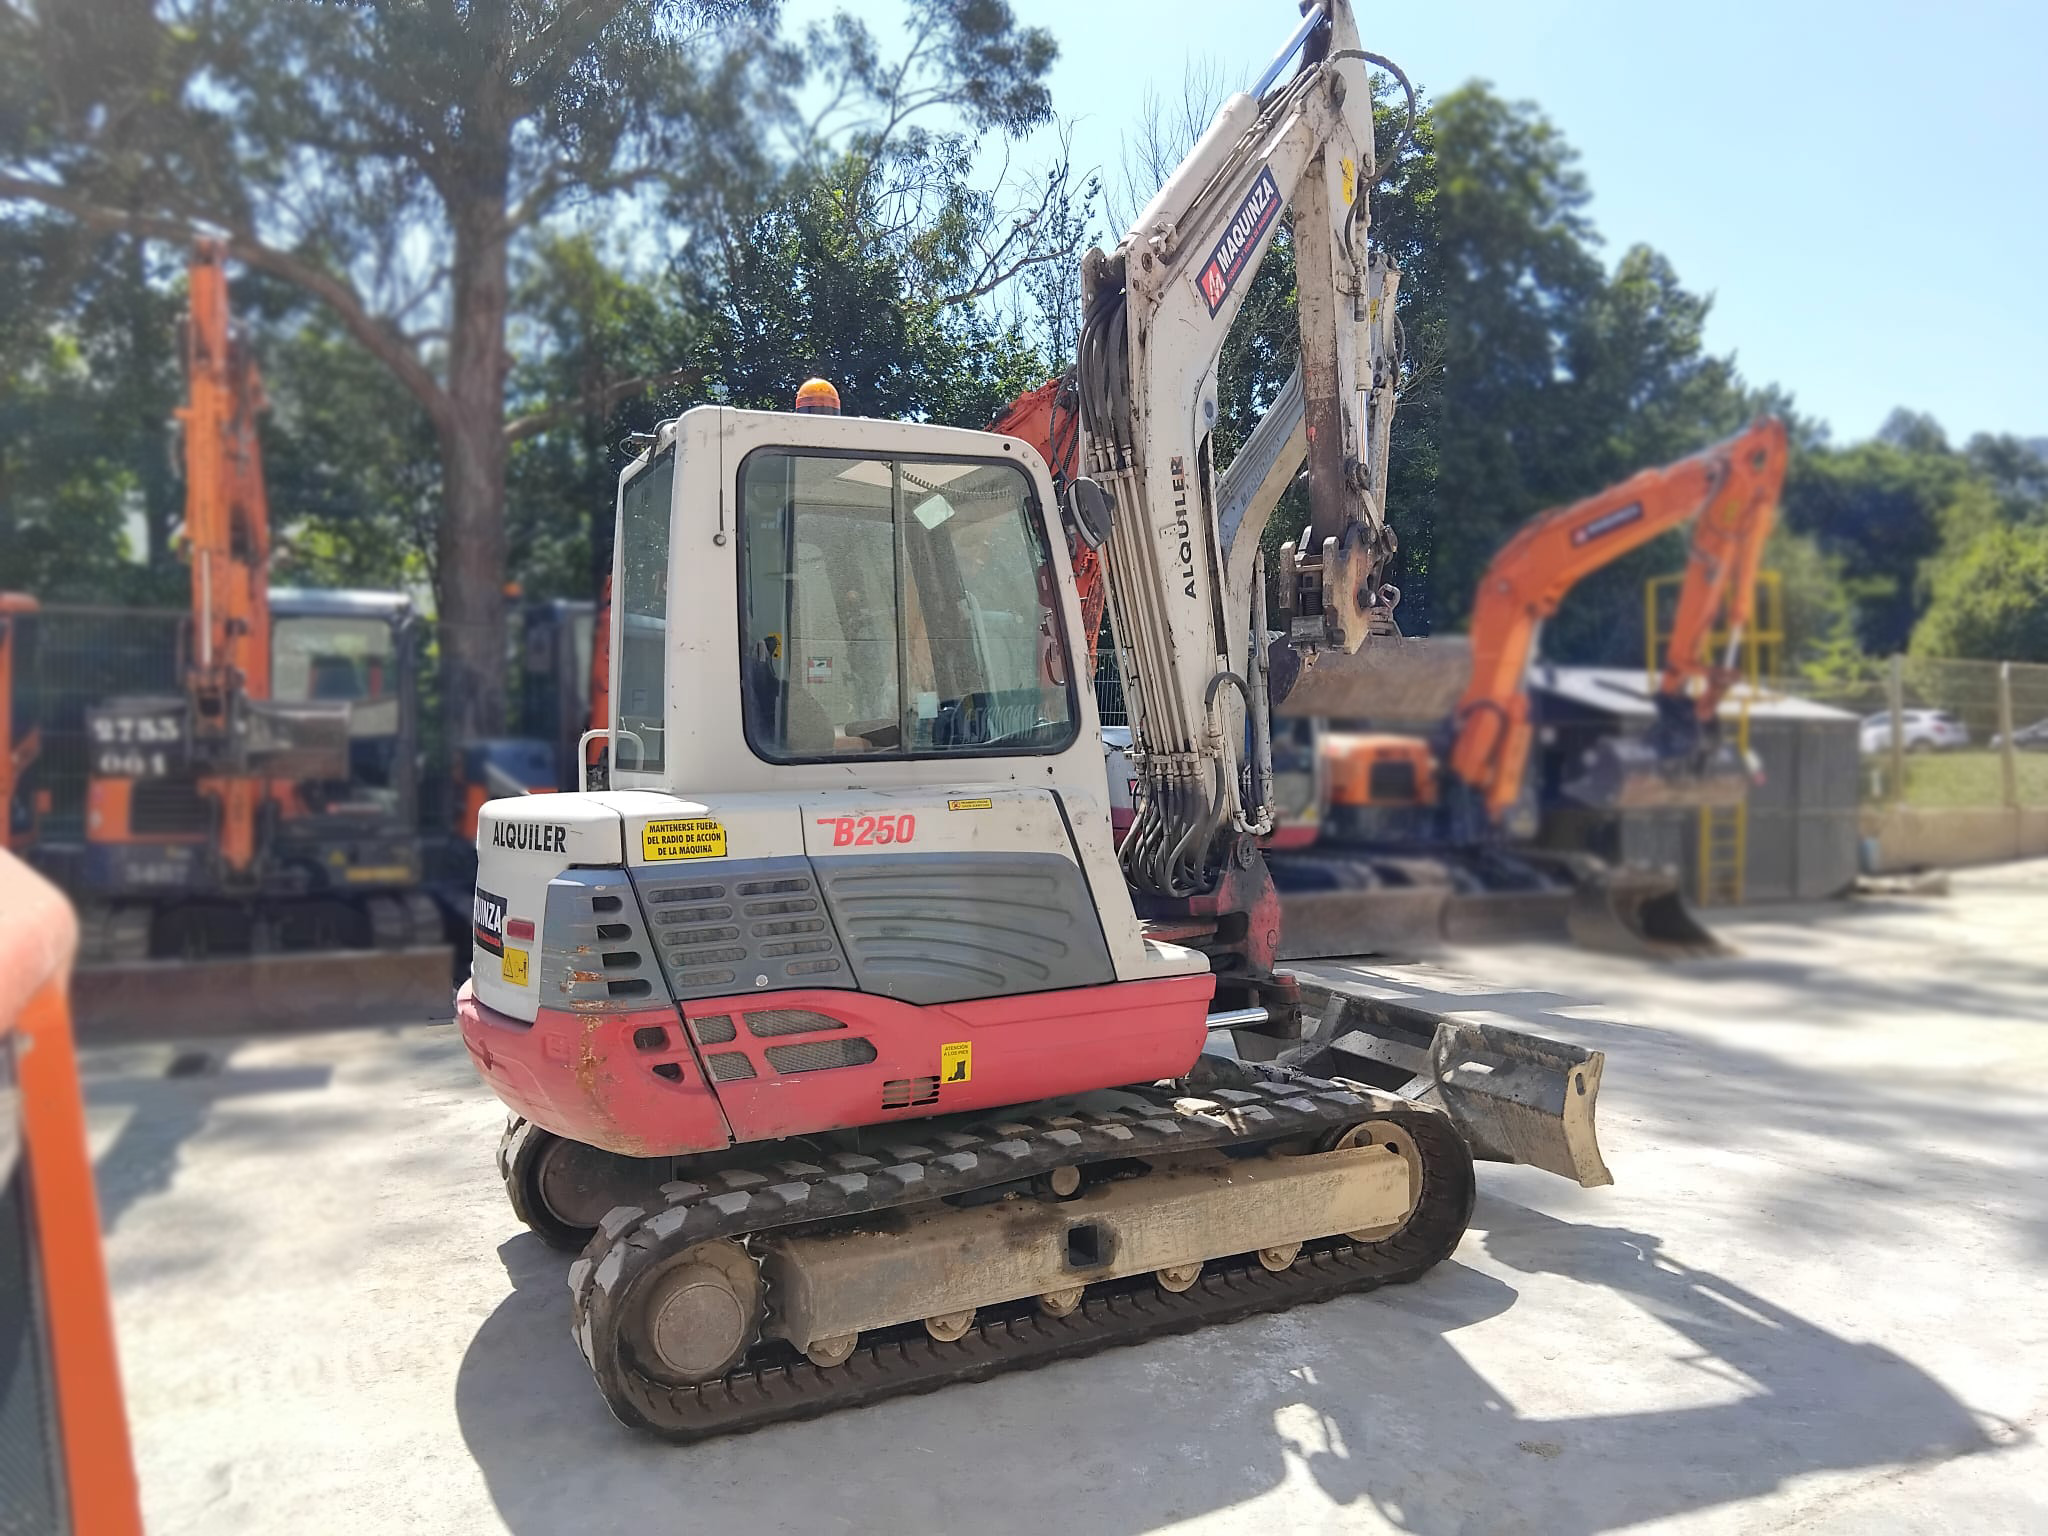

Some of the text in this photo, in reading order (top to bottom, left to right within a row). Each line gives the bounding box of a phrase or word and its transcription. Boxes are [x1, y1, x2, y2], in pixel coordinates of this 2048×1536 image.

[1216, 177, 1275, 274] MAQUINZA
[1170, 456, 1197, 600] ALQUILER
[492, 821, 567, 853] ALQUILER
[647, 831, 721, 845] DEL RADIO DE ACCIÓN
[649, 822, 718, 833] MANTENERSE FUERA
[657, 844, 713, 856] DE LA MÁQUINA
